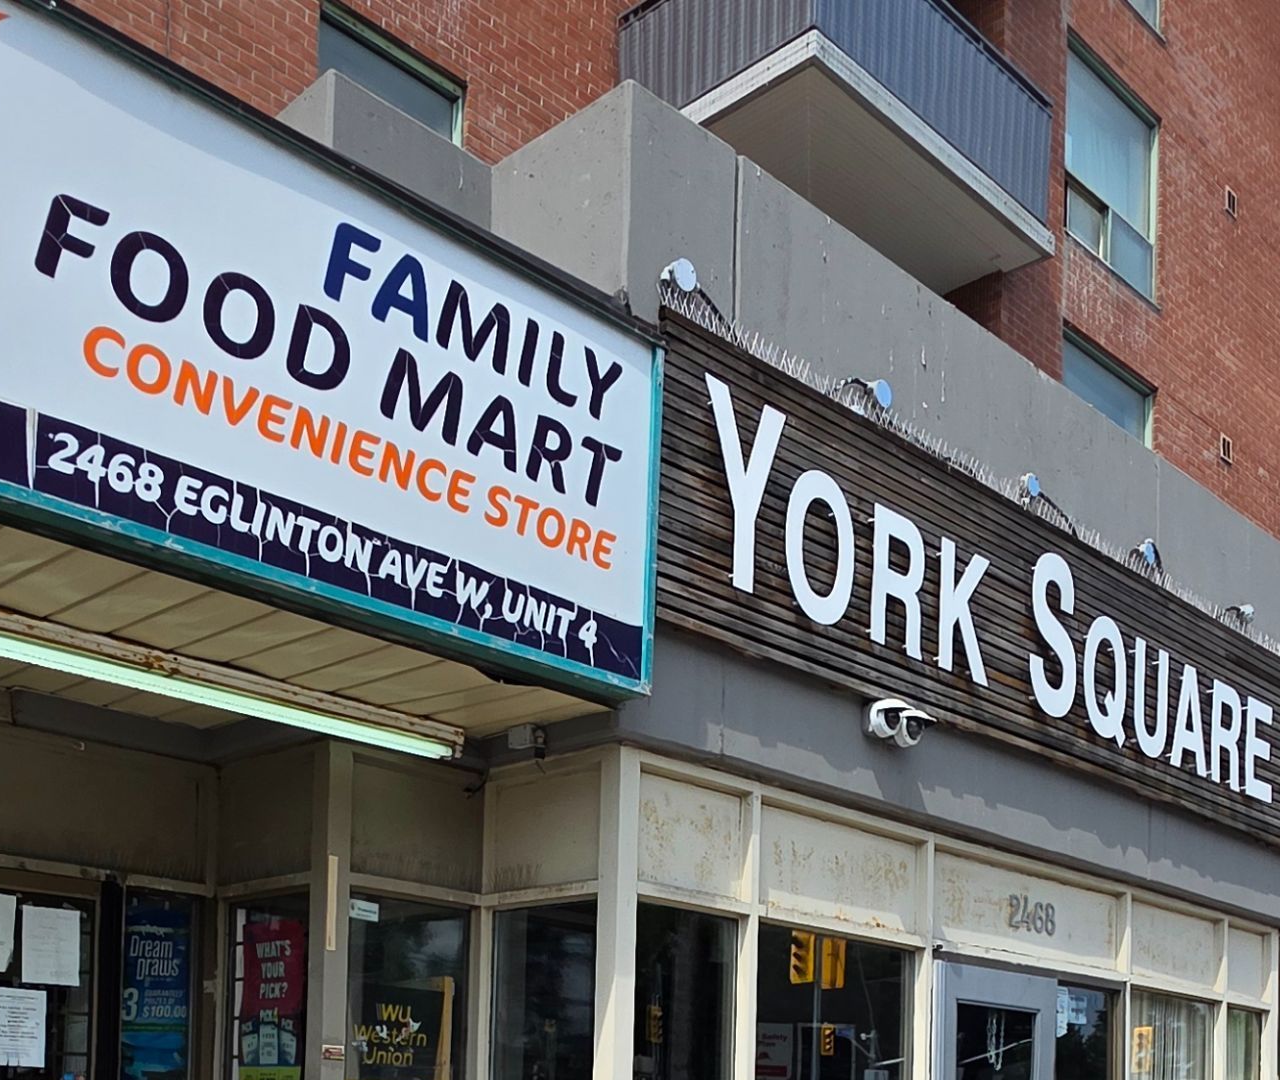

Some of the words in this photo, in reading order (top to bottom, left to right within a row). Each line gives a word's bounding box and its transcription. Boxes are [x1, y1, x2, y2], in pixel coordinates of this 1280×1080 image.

[322, 221, 623, 421] FAMILY
[34, 194, 350, 391] FOOD
[379, 347, 623, 507] MART
[83, 326, 476, 514] CONVENIENCE
[484, 485, 617, 570] STORE
[48, 432, 165, 502] 2468
[175, 478, 386, 574] EGLINTON
[378, 546, 445, 597] AVE
[501, 587, 578, 646] UNIT
[578, 616, 598, 650] 4
[705, 372, 991, 688] YORK
[1029, 552, 1274, 804] SQUARE
[1008, 894, 1056, 937] 2468
[130, 935, 173, 958] Dream
[255, 939, 292, 959] WHAT'S
[136, 958, 180, 980] Draws
[261, 961, 285, 979] YOUR
[122, 987, 139, 1021] 3
[259, 982, 288, 1000] PICK?
[362, 1045, 414, 1067] Union
